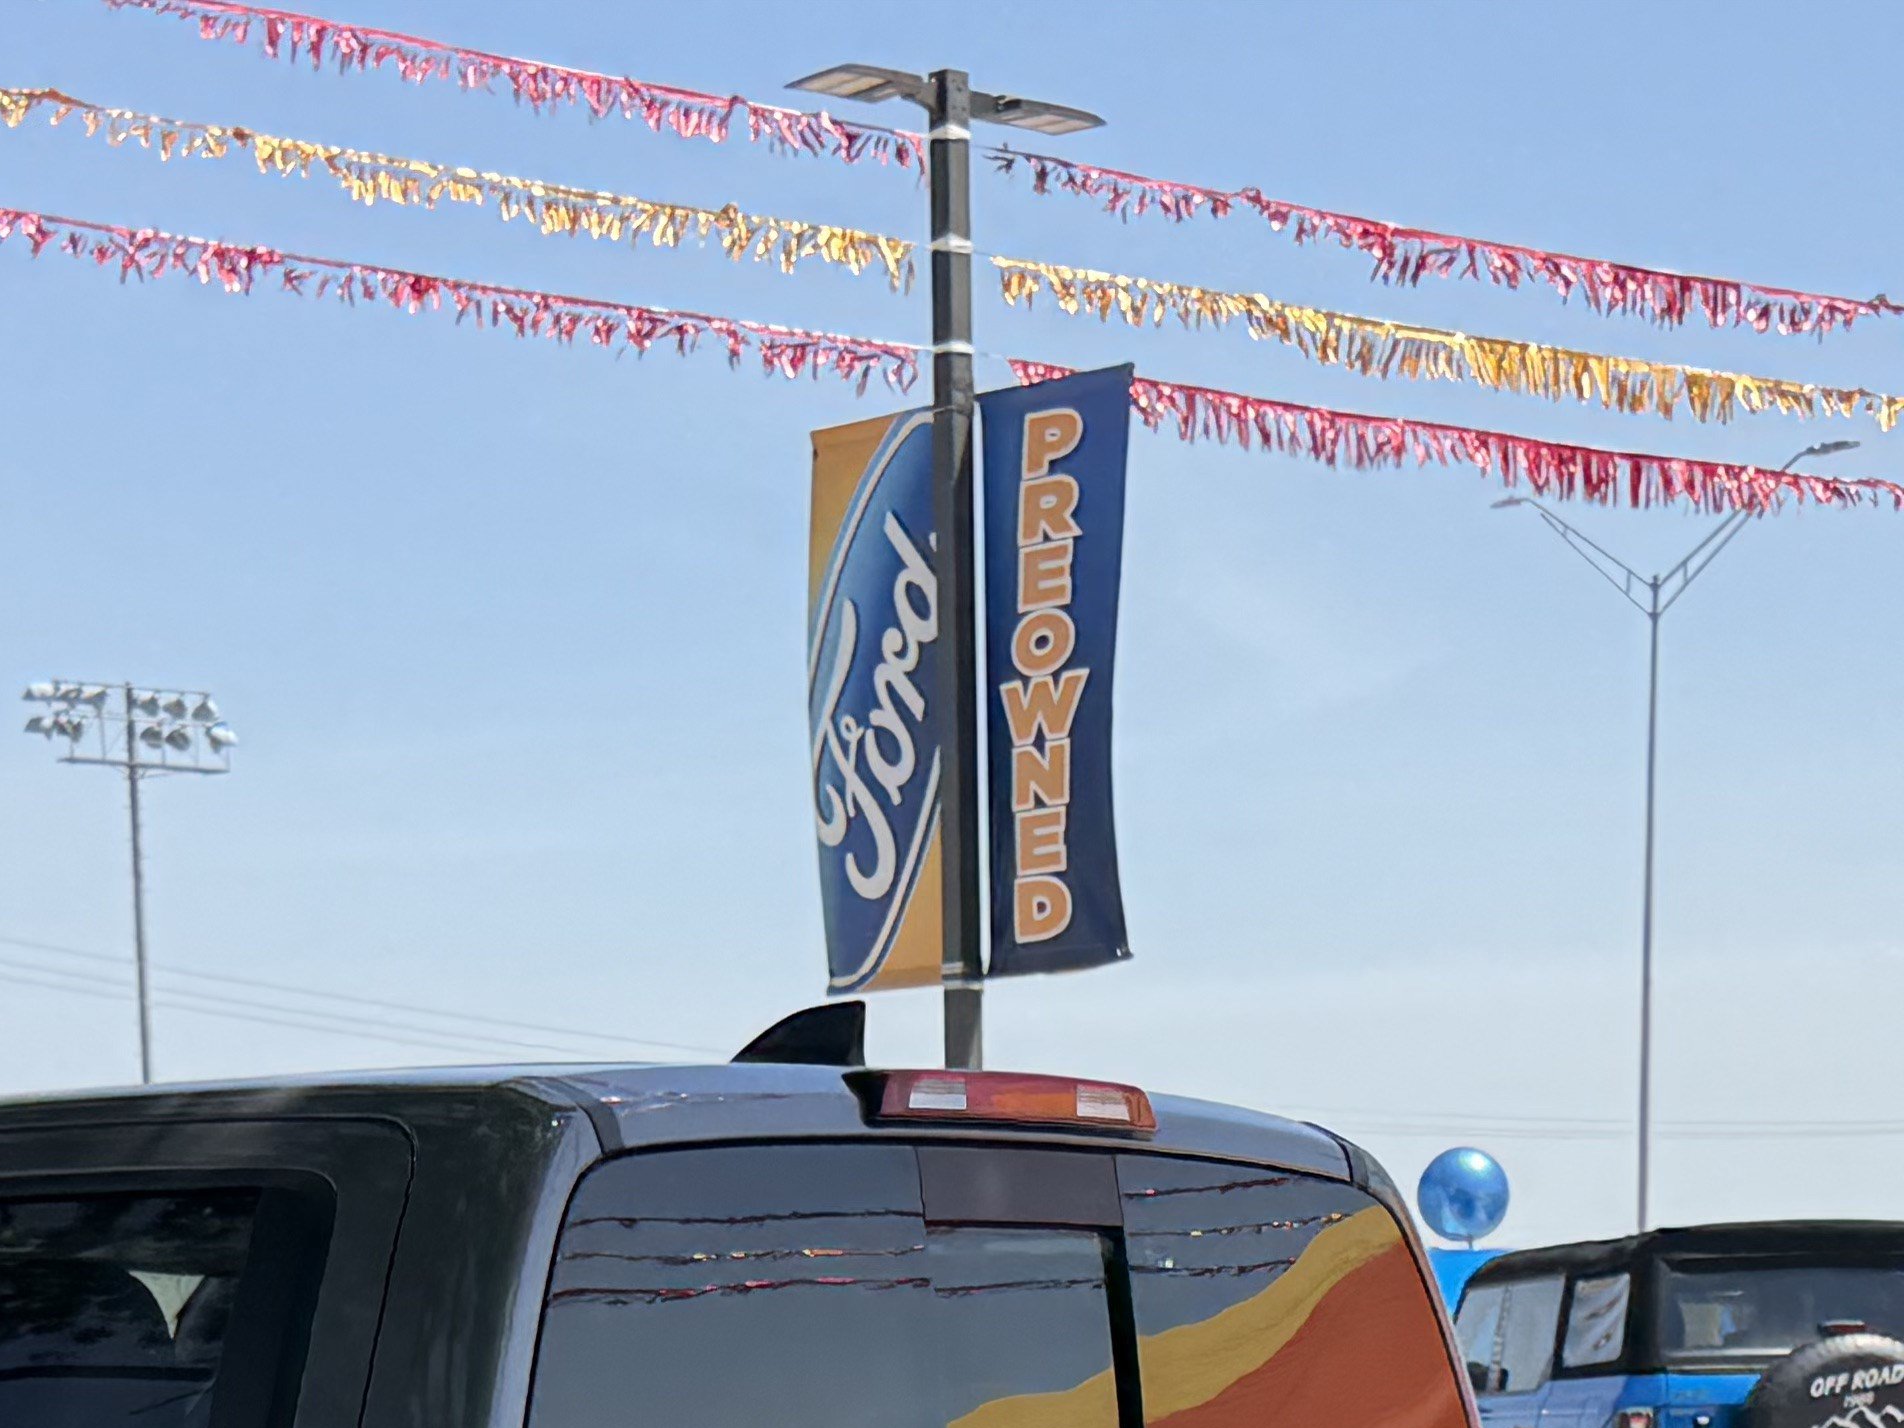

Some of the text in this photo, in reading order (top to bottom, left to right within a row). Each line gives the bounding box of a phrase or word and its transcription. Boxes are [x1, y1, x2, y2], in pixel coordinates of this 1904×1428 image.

[813, 509, 939, 900] Ford
[999, 407, 1090, 944] PREOWNED
[1810, 1373, 1850, 1398] OFF
